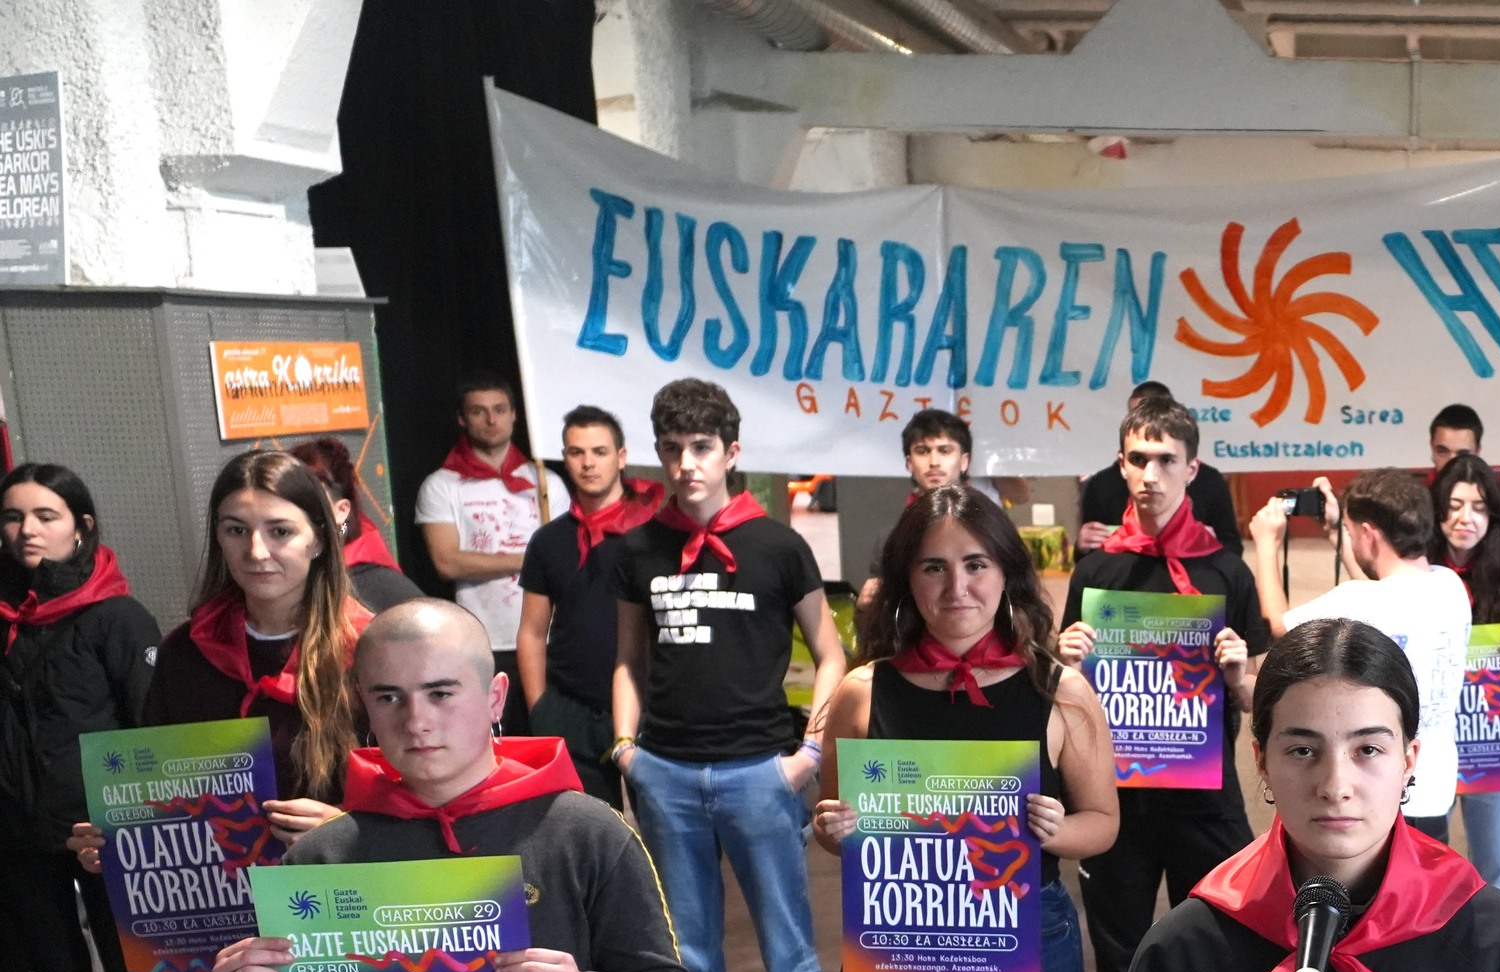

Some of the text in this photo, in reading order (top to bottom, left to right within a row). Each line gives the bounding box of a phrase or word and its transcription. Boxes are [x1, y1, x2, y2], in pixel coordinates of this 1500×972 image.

[20, 171, 59, 194] MAYS
[0, 195, 59, 220] ELOREAN
[577, 187, 1166, 389] EUSKARAREN
[1189, 406, 1404, 424] azte Sarea
[1095, 659, 1177, 693] OLATUA
[1110, 731, 1128, 740] :30
[167, 758, 227, 773] MARTXOAK
[232, 756, 248, 767] 29
[103, 771, 254, 805] GAZTE EUSKALTZALEON
[931, 779, 1017, 790] MARTXOAK 29
[858, 793, 1019, 816] GAZTE EUSKALTZALEON
[863, 819, 909, 830] BILBON
[115, 821, 225, 870] OLATUA
[861, 836, 975, 881] OLATUA
[124, 864, 255, 914] KORRIKA
[381, 904, 495, 923] MARTXOAK 29
[863, 881, 1018, 928] KORRIKAN
[142, 921, 178, 932] 10:30
[287, 932, 344, 958] GAZTE
[352, 925, 502, 956] EUSKALTZALEON
[872, 934, 909, 945] 10:30
[915, 935, 931, 946] LA
[891, 954, 915, 962] 13:30
[918, 954, 937, 962] Hots
